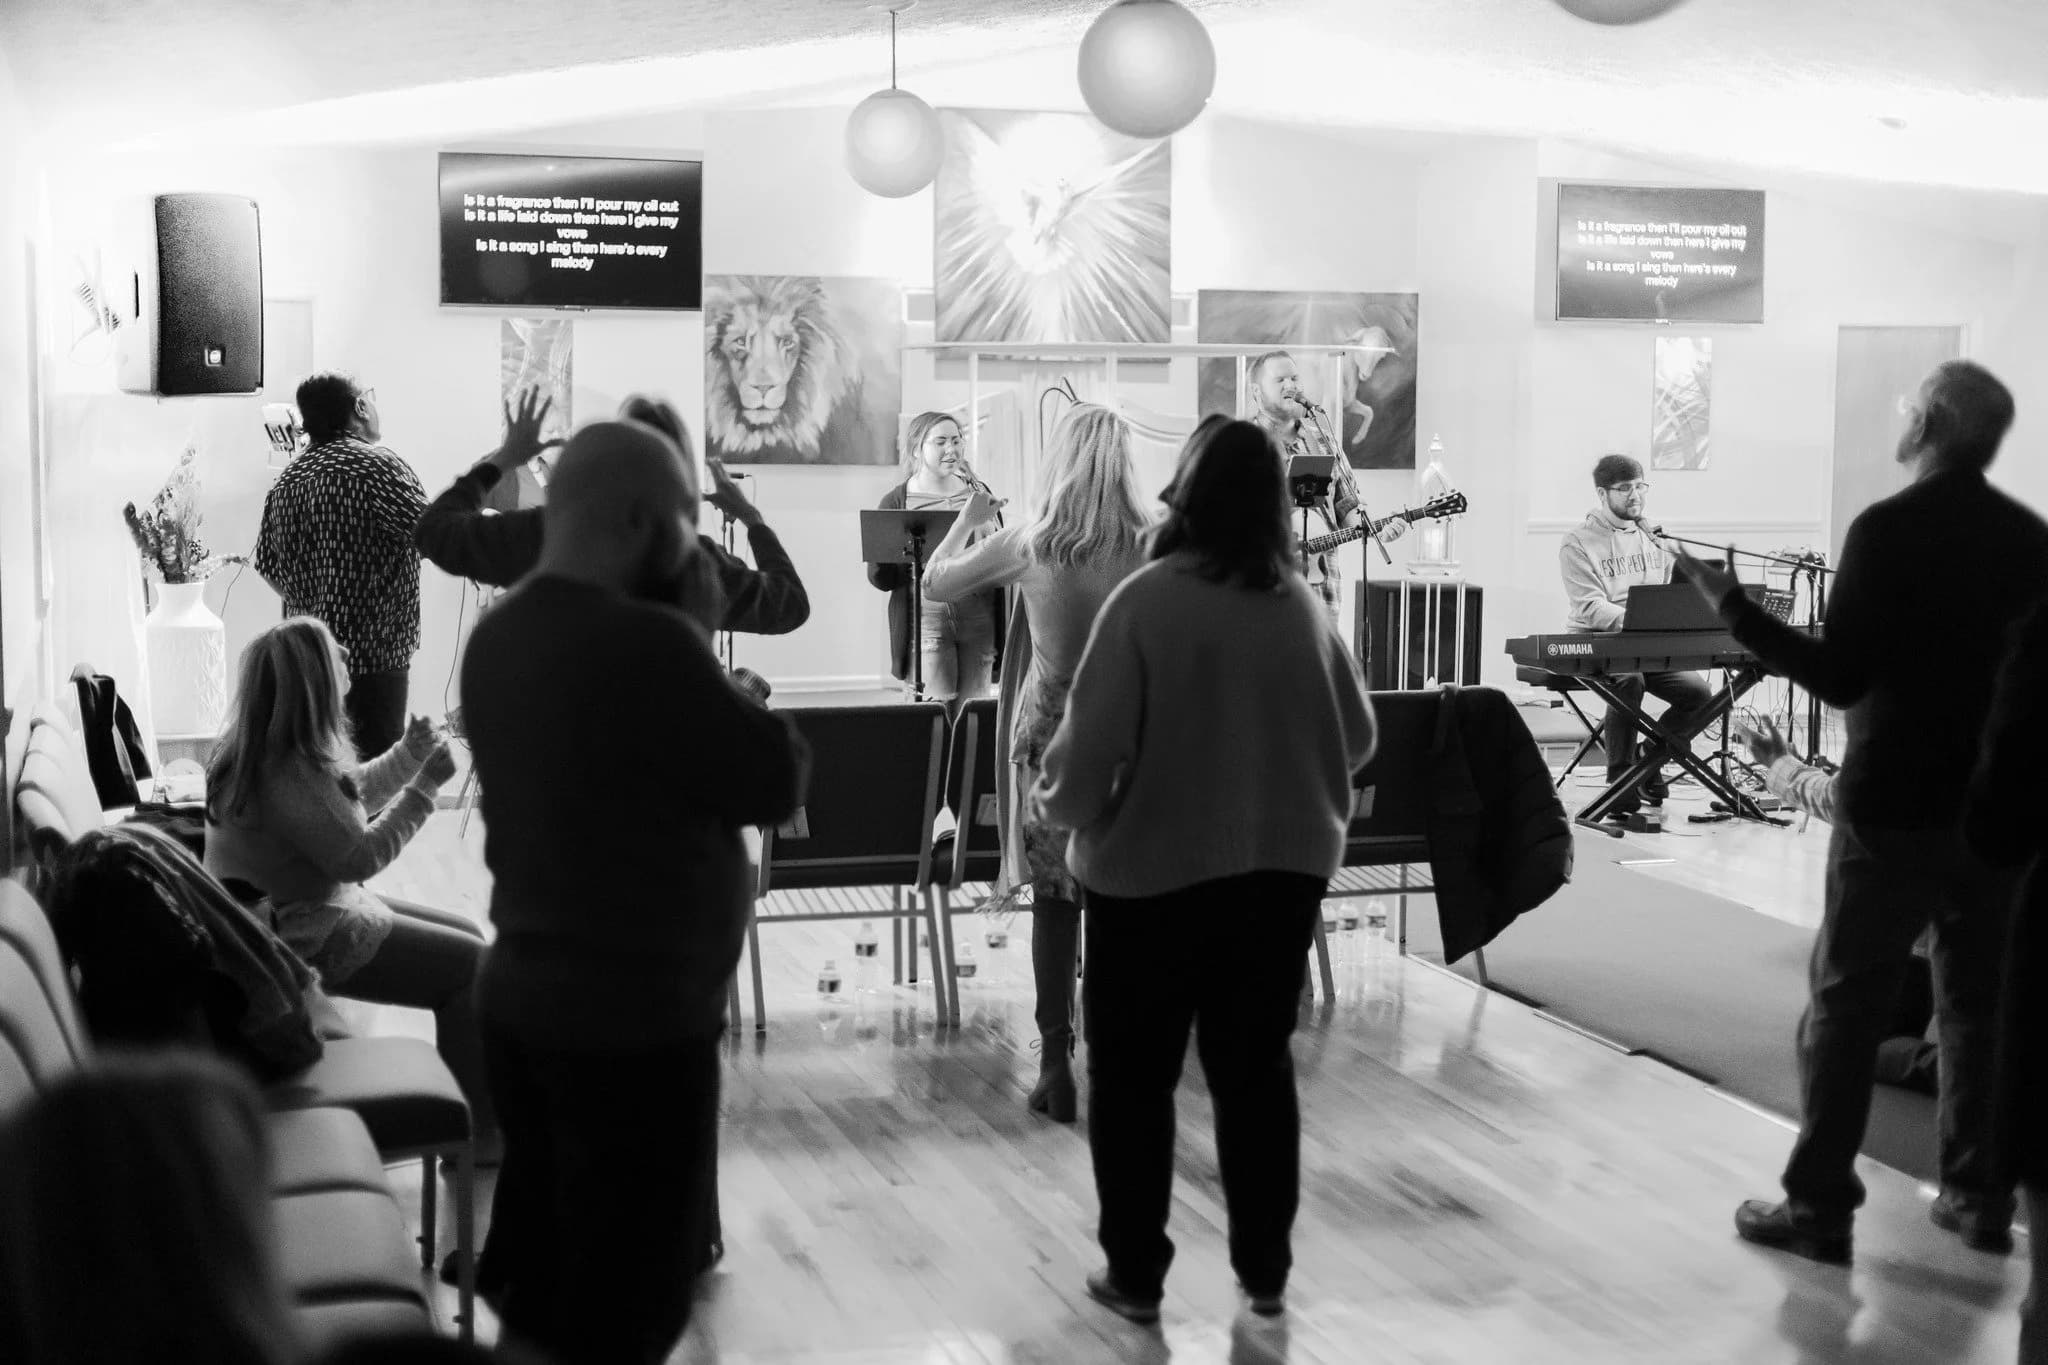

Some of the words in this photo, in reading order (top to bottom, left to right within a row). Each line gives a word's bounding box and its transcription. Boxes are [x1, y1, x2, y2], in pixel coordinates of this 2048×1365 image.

[464, 194, 476, 207] Is
[477, 195, 485, 207] it
[487, 197, 496, 207] a
[497, 195, 552, 210] fragrance
[552, 197, 579, 209] then
[580, 197, 595, 210] I'll
[595, 200, 623, 212] pour
[623, 201, 643, 213] my
[643, 199, 659, 212] oil
[659, 201, 680, 212] out
[464, 209, 476, 222] Is
[477, 209, 486, 222] it
[487, 211, 497, 222] a
[497, 209, 516, 223] life
[517, 210, 539, 223] laid
[540, 211, 573, 224] down
[573, 212, 600, 225] then
[601, 212, 627, 225] here
[628, 213, 634, 226] I
[634, 214, 659, 228] give
[659, 217, 679, 229] my
[556, 228, 588, 240] vows
[476, 238, 488, 252] Is
[489, 239, 498, 252] it
[498, 241, 508, 252] a
[509, 242, 539, 255] song
[540, 240, 545, 253] I
[546, 241, 571, 256] sing
[572, 241, 599, 254] then
[599, 241, 635, 255] here's
[635, 245, 668, 259] every
[551, 255, 594, 271] melody
[1645, 275, 1679, 289] melody
[1558, 643, 1594, 655] YAMAHA
